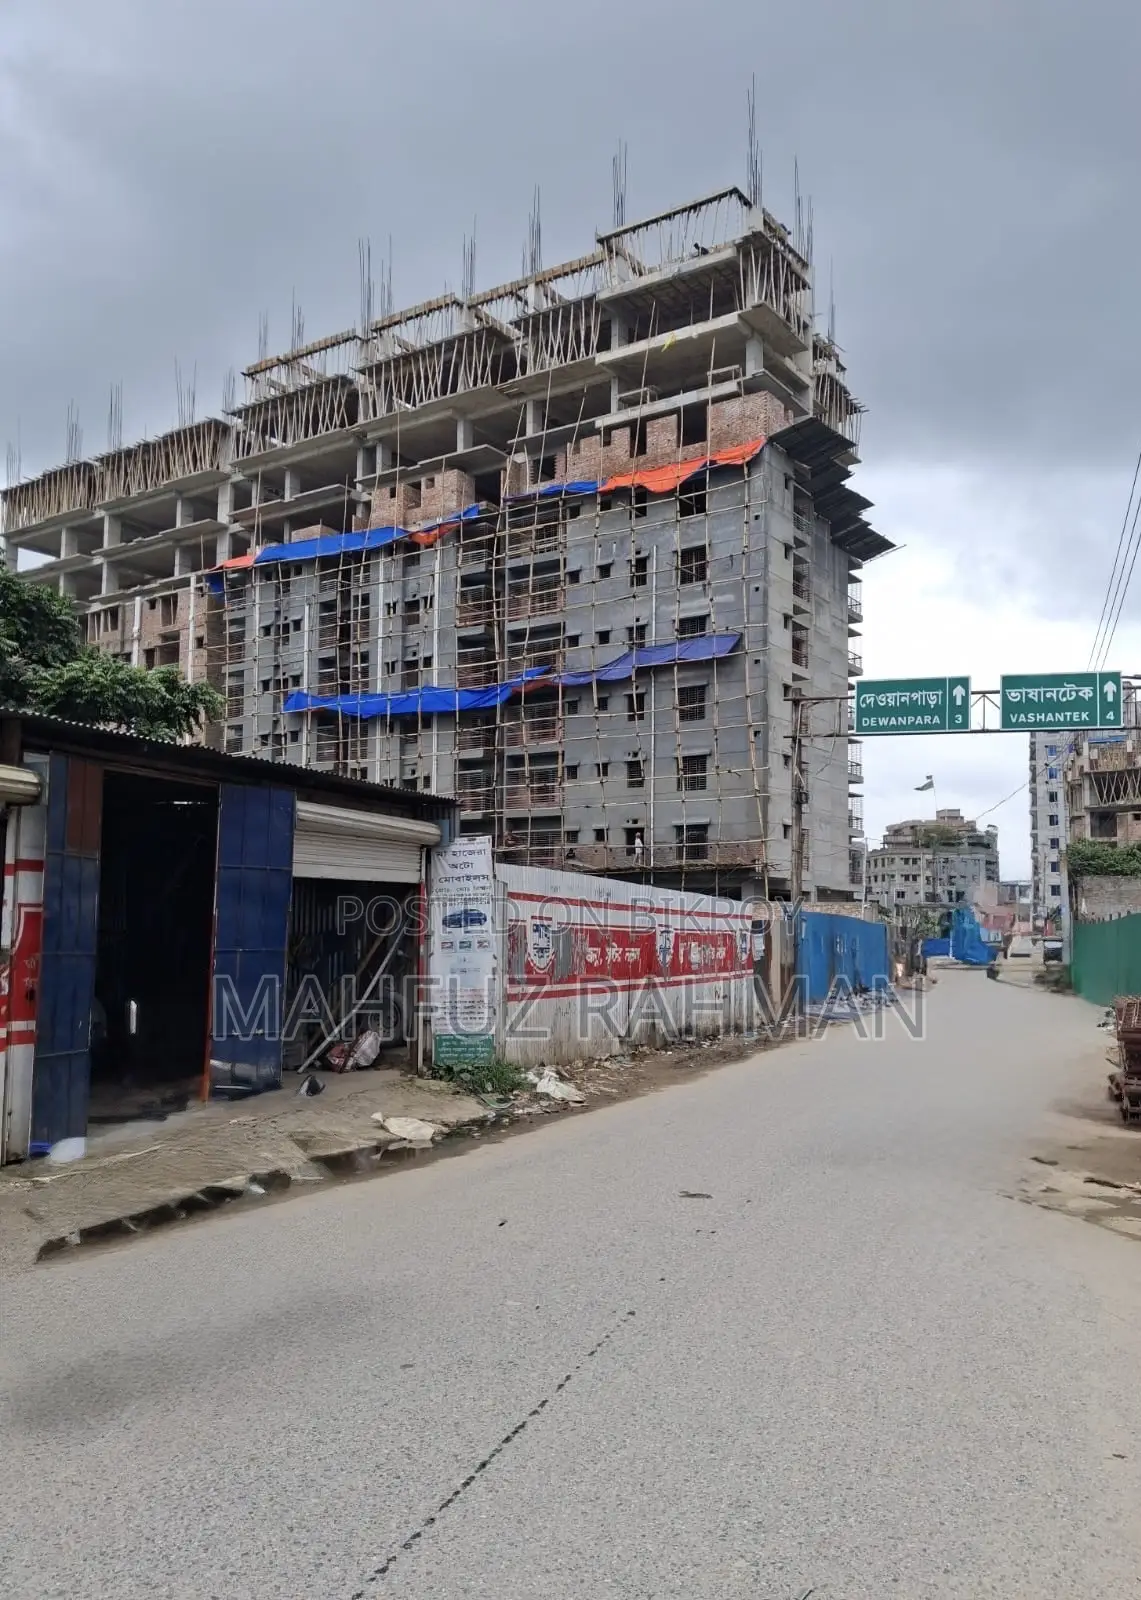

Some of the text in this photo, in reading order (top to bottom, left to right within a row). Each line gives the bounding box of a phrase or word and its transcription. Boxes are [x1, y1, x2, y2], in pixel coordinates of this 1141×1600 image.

[860, 689, 943, 709] দেওয়ানপাড়া
[1005, 682, 1094, 704] ভাষানটেক
[862, 715, 941, 727] DEWANPARA
[954, 714, 963, 724] 3
[1010, 711, 1090, 723] VASHANTEK
[1105, 711, 1115, 721] 4
[448, 861, 474, 870] অটো
